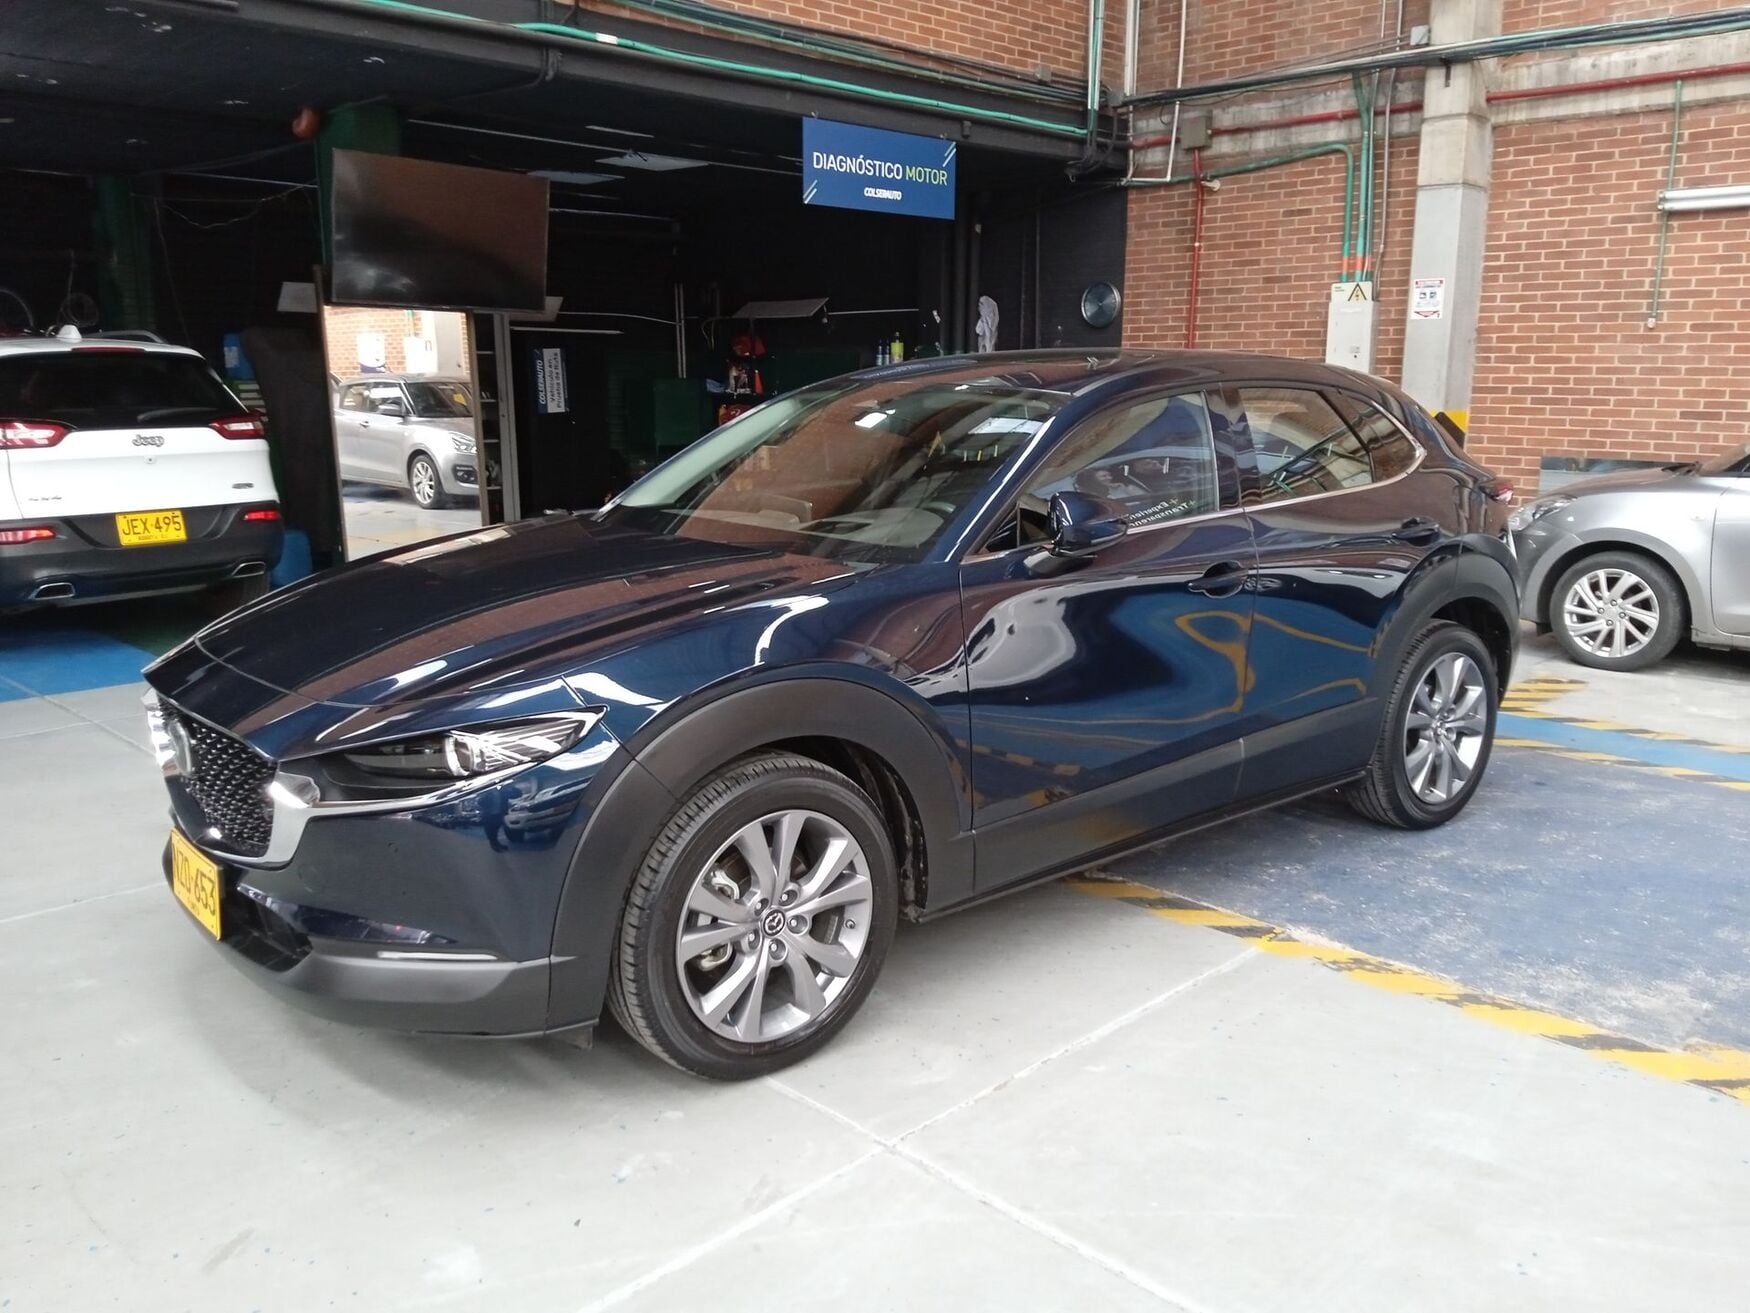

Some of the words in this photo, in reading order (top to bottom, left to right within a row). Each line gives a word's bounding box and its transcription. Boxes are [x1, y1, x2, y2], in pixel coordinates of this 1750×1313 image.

[812, 151, 903, 180] DIAGNÓSTICO
[905, 165, 948, 186] MOTOR
[132, 434, 165, 447] Jeep
